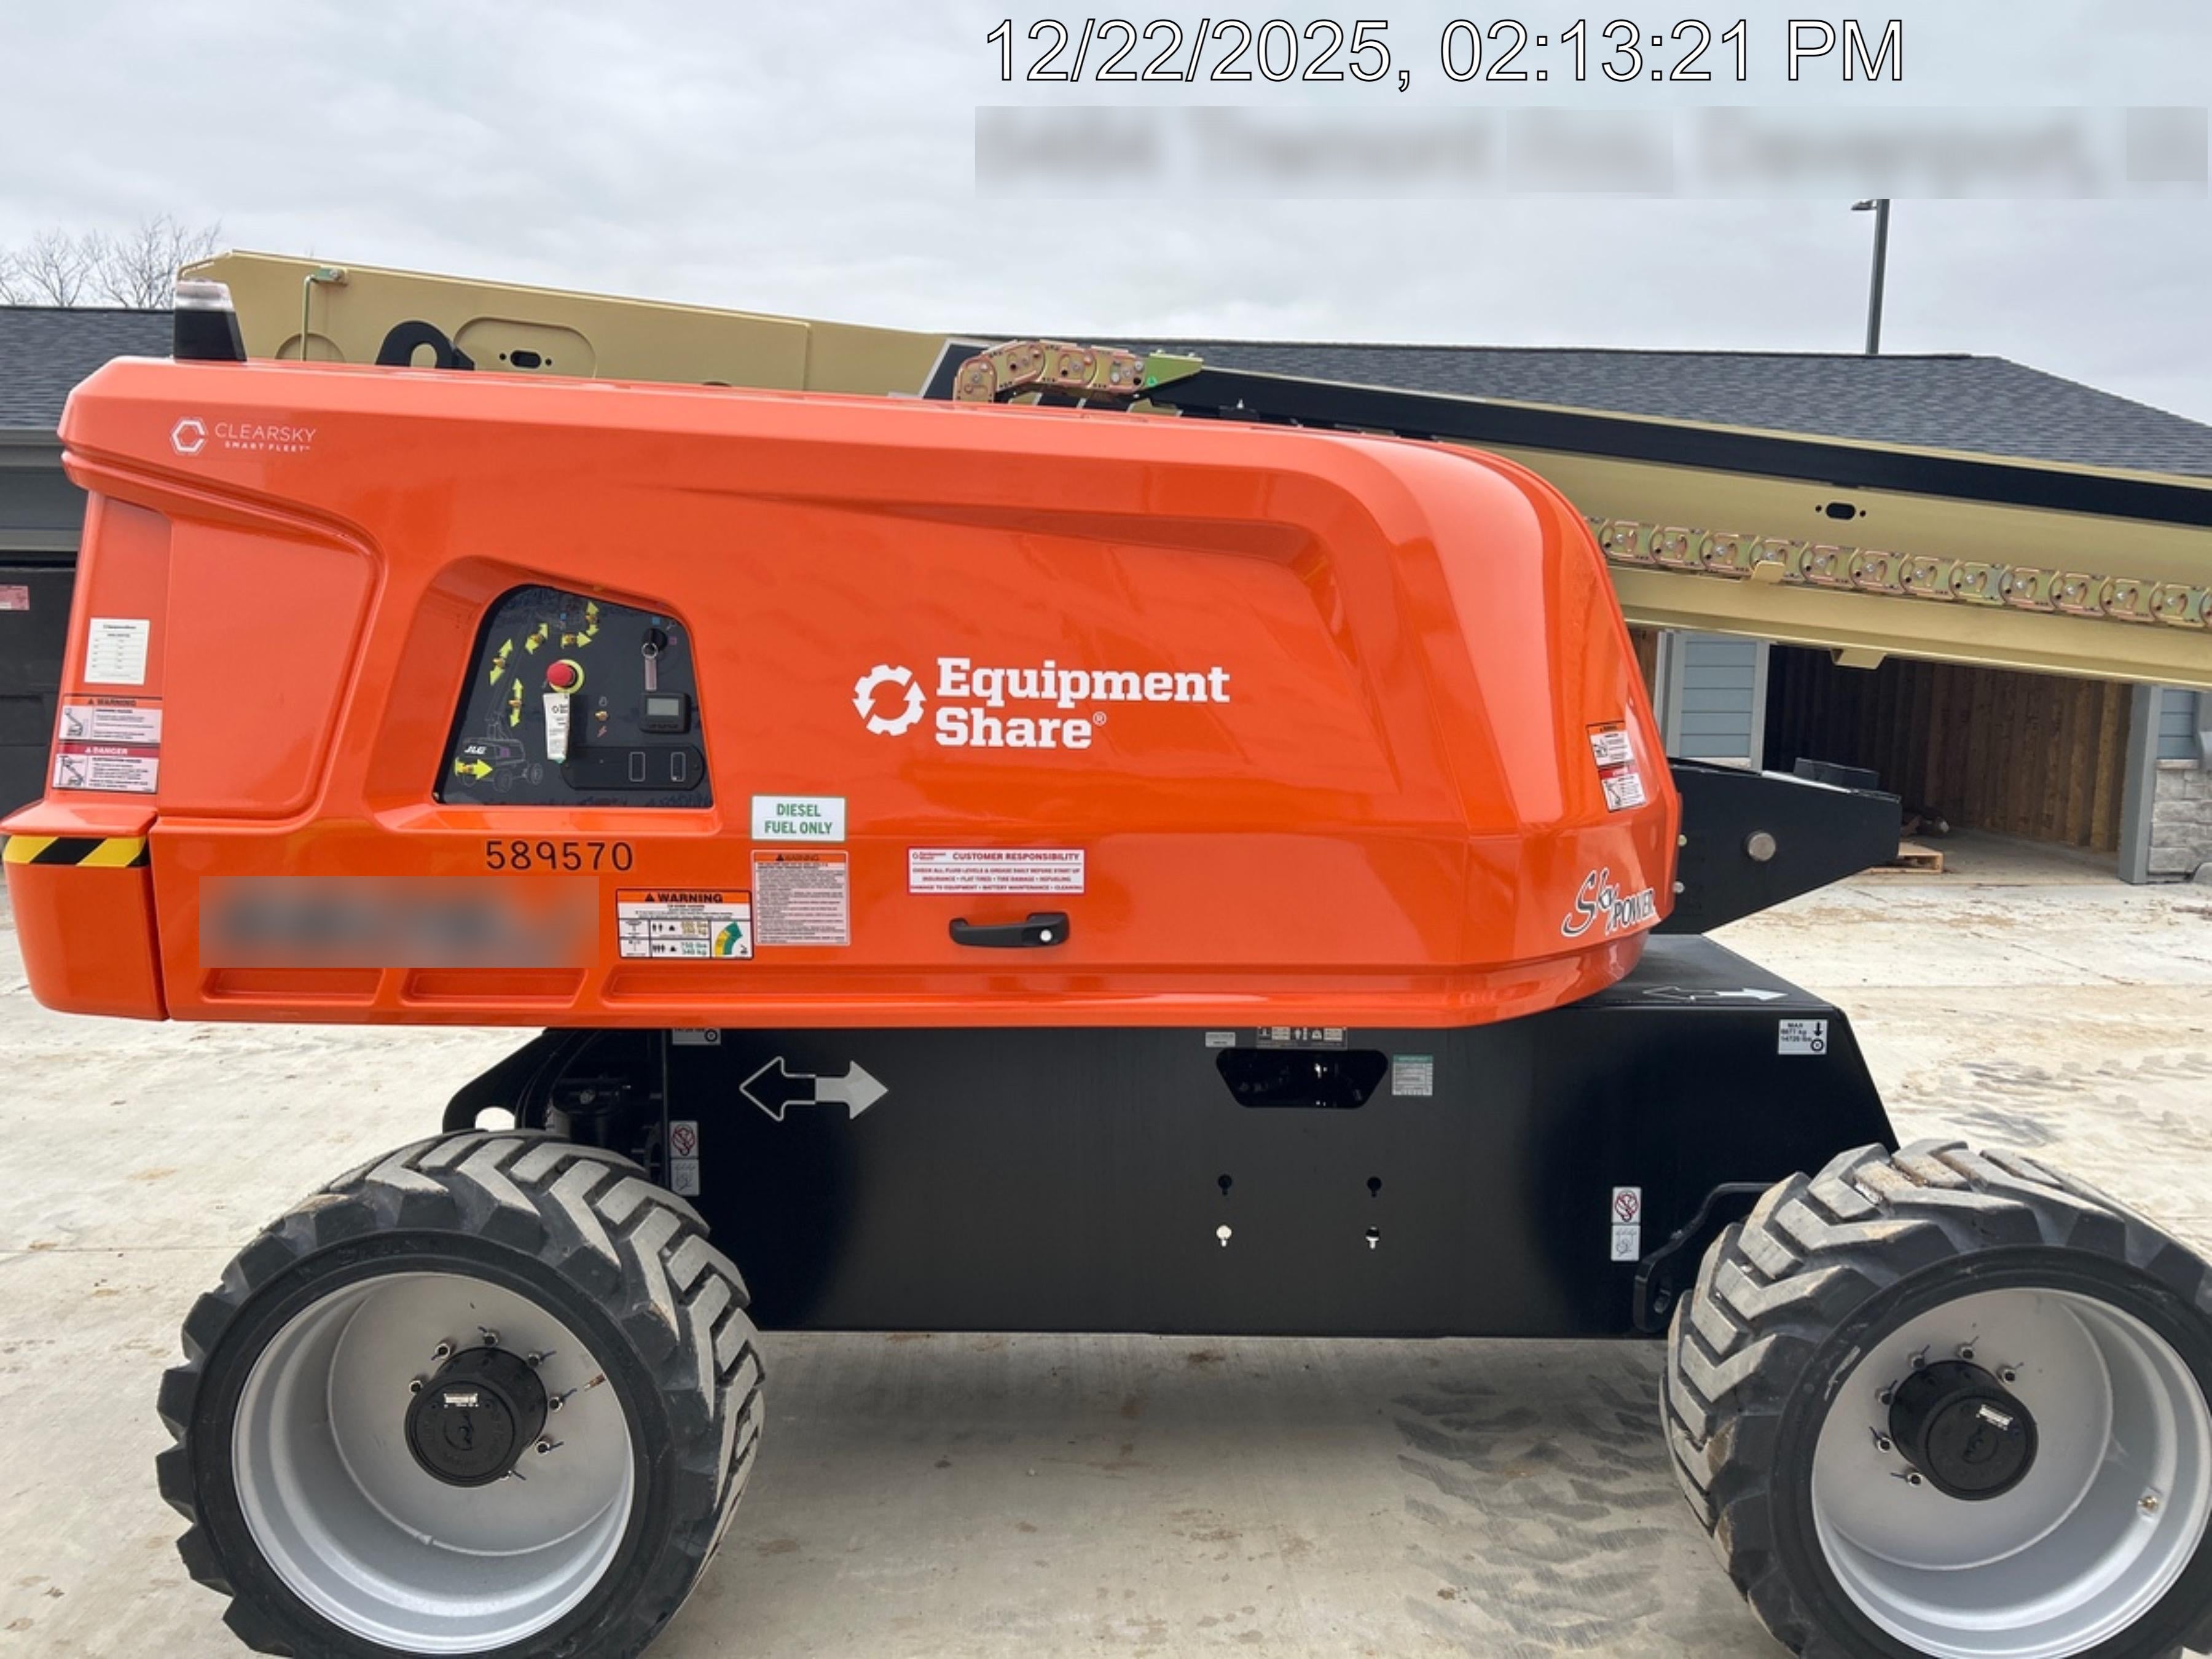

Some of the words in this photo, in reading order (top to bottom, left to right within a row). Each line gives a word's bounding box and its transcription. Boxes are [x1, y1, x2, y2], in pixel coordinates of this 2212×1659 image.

[215, 422, 316, 442] CLEARSKY
[937, 657, 1230, 708] Equipment
[777, 803, 822, 817] DIESEL
[764, 821, 796, 833] FUEL
[799, 822, 833, 834] ONLY
[486, 840, 632, 871] 589570
[659, 894, 723, 903] WARNING
